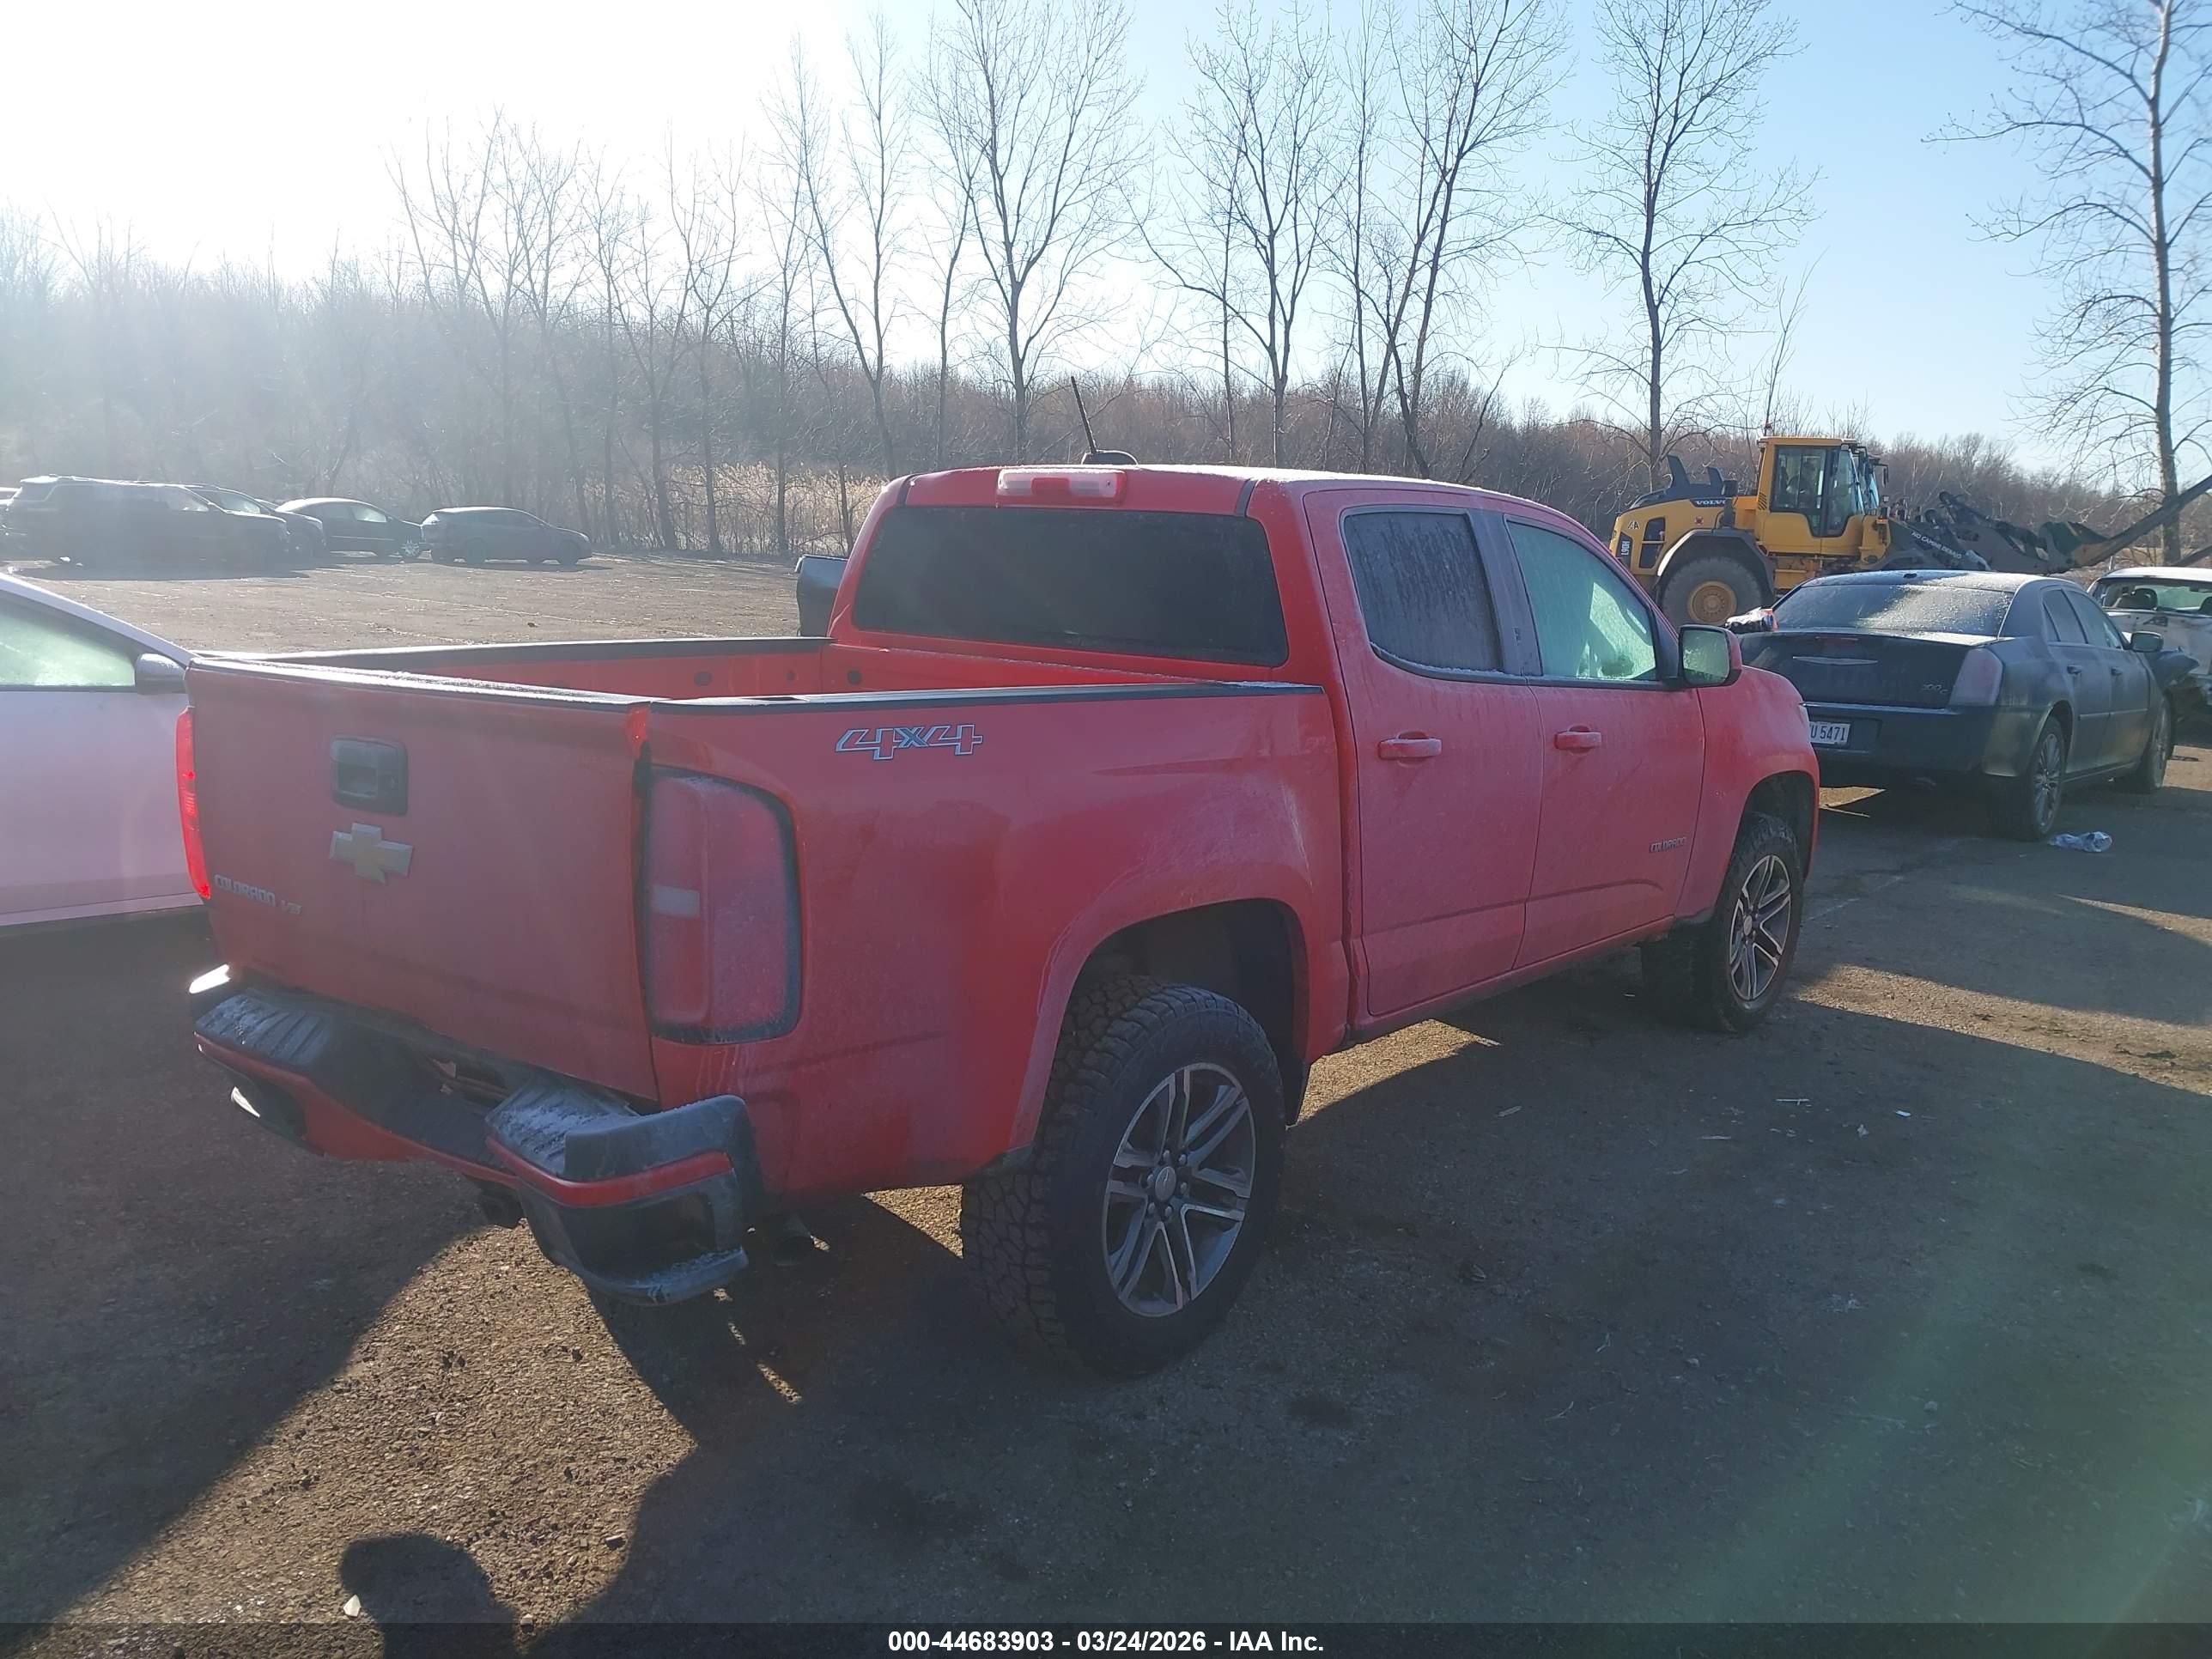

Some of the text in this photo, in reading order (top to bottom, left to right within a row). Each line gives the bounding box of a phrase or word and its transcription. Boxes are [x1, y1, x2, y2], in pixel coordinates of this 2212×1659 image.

[1808, 723, 1846, 741] U 5471
[214, 874, 276, 908] COLORADO
